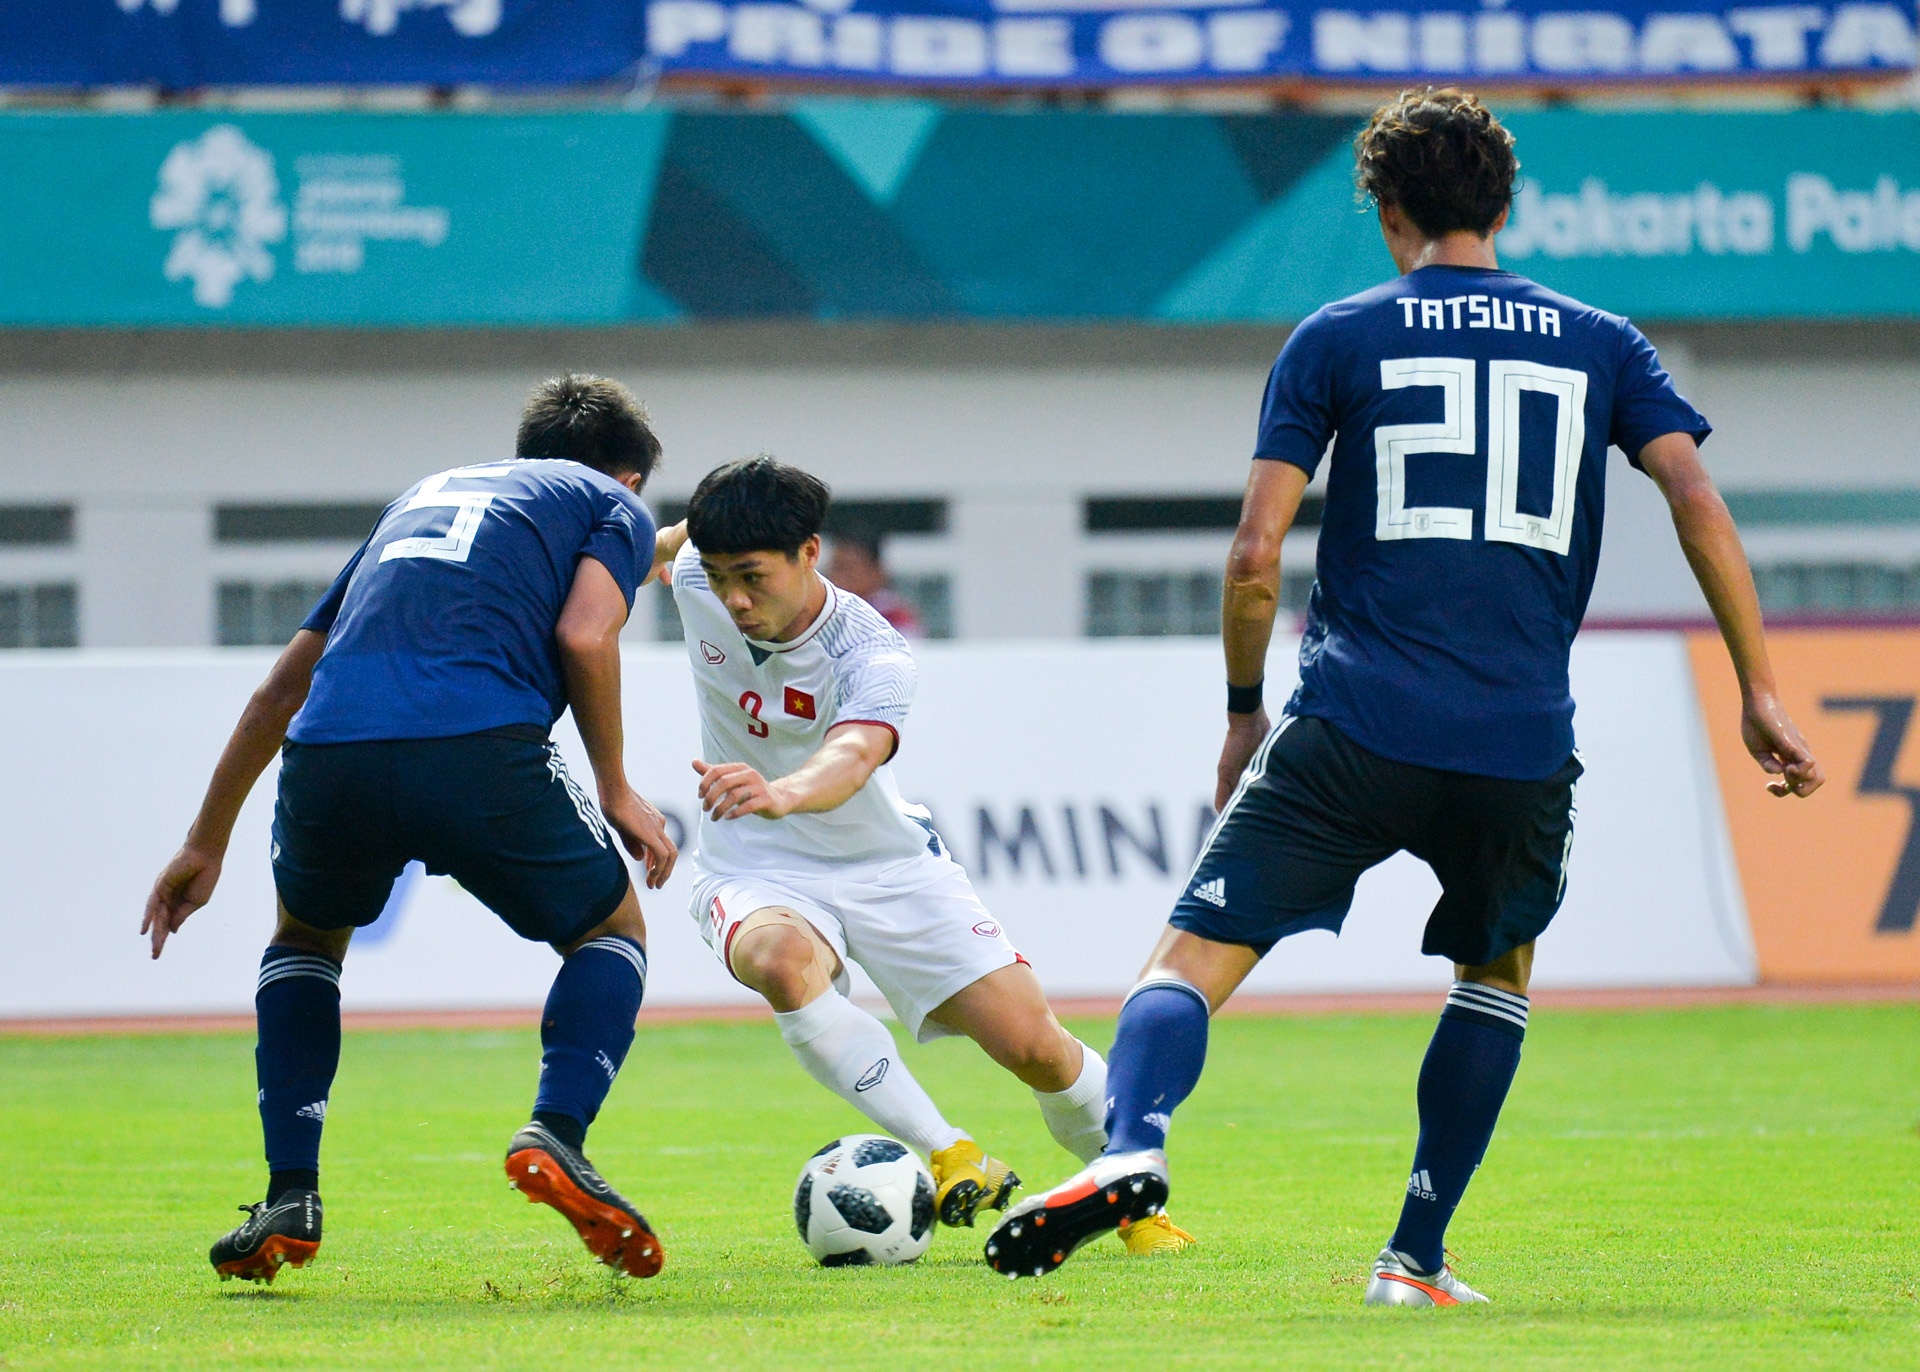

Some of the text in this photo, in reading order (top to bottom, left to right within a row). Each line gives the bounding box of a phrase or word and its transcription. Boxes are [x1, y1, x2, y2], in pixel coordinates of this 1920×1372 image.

[646, 2, 1076, 77] PRIDE
[1101, 13, 1292, 72] OF
[1502, 176, 1774, 258] Jakarta
[1396, 294, 1561, 338] TATSUTA
[1374, 356, 1588, 557] 20
[377, 466, 517, 565] 5
[1193, 887, 1227, 908] adidas
